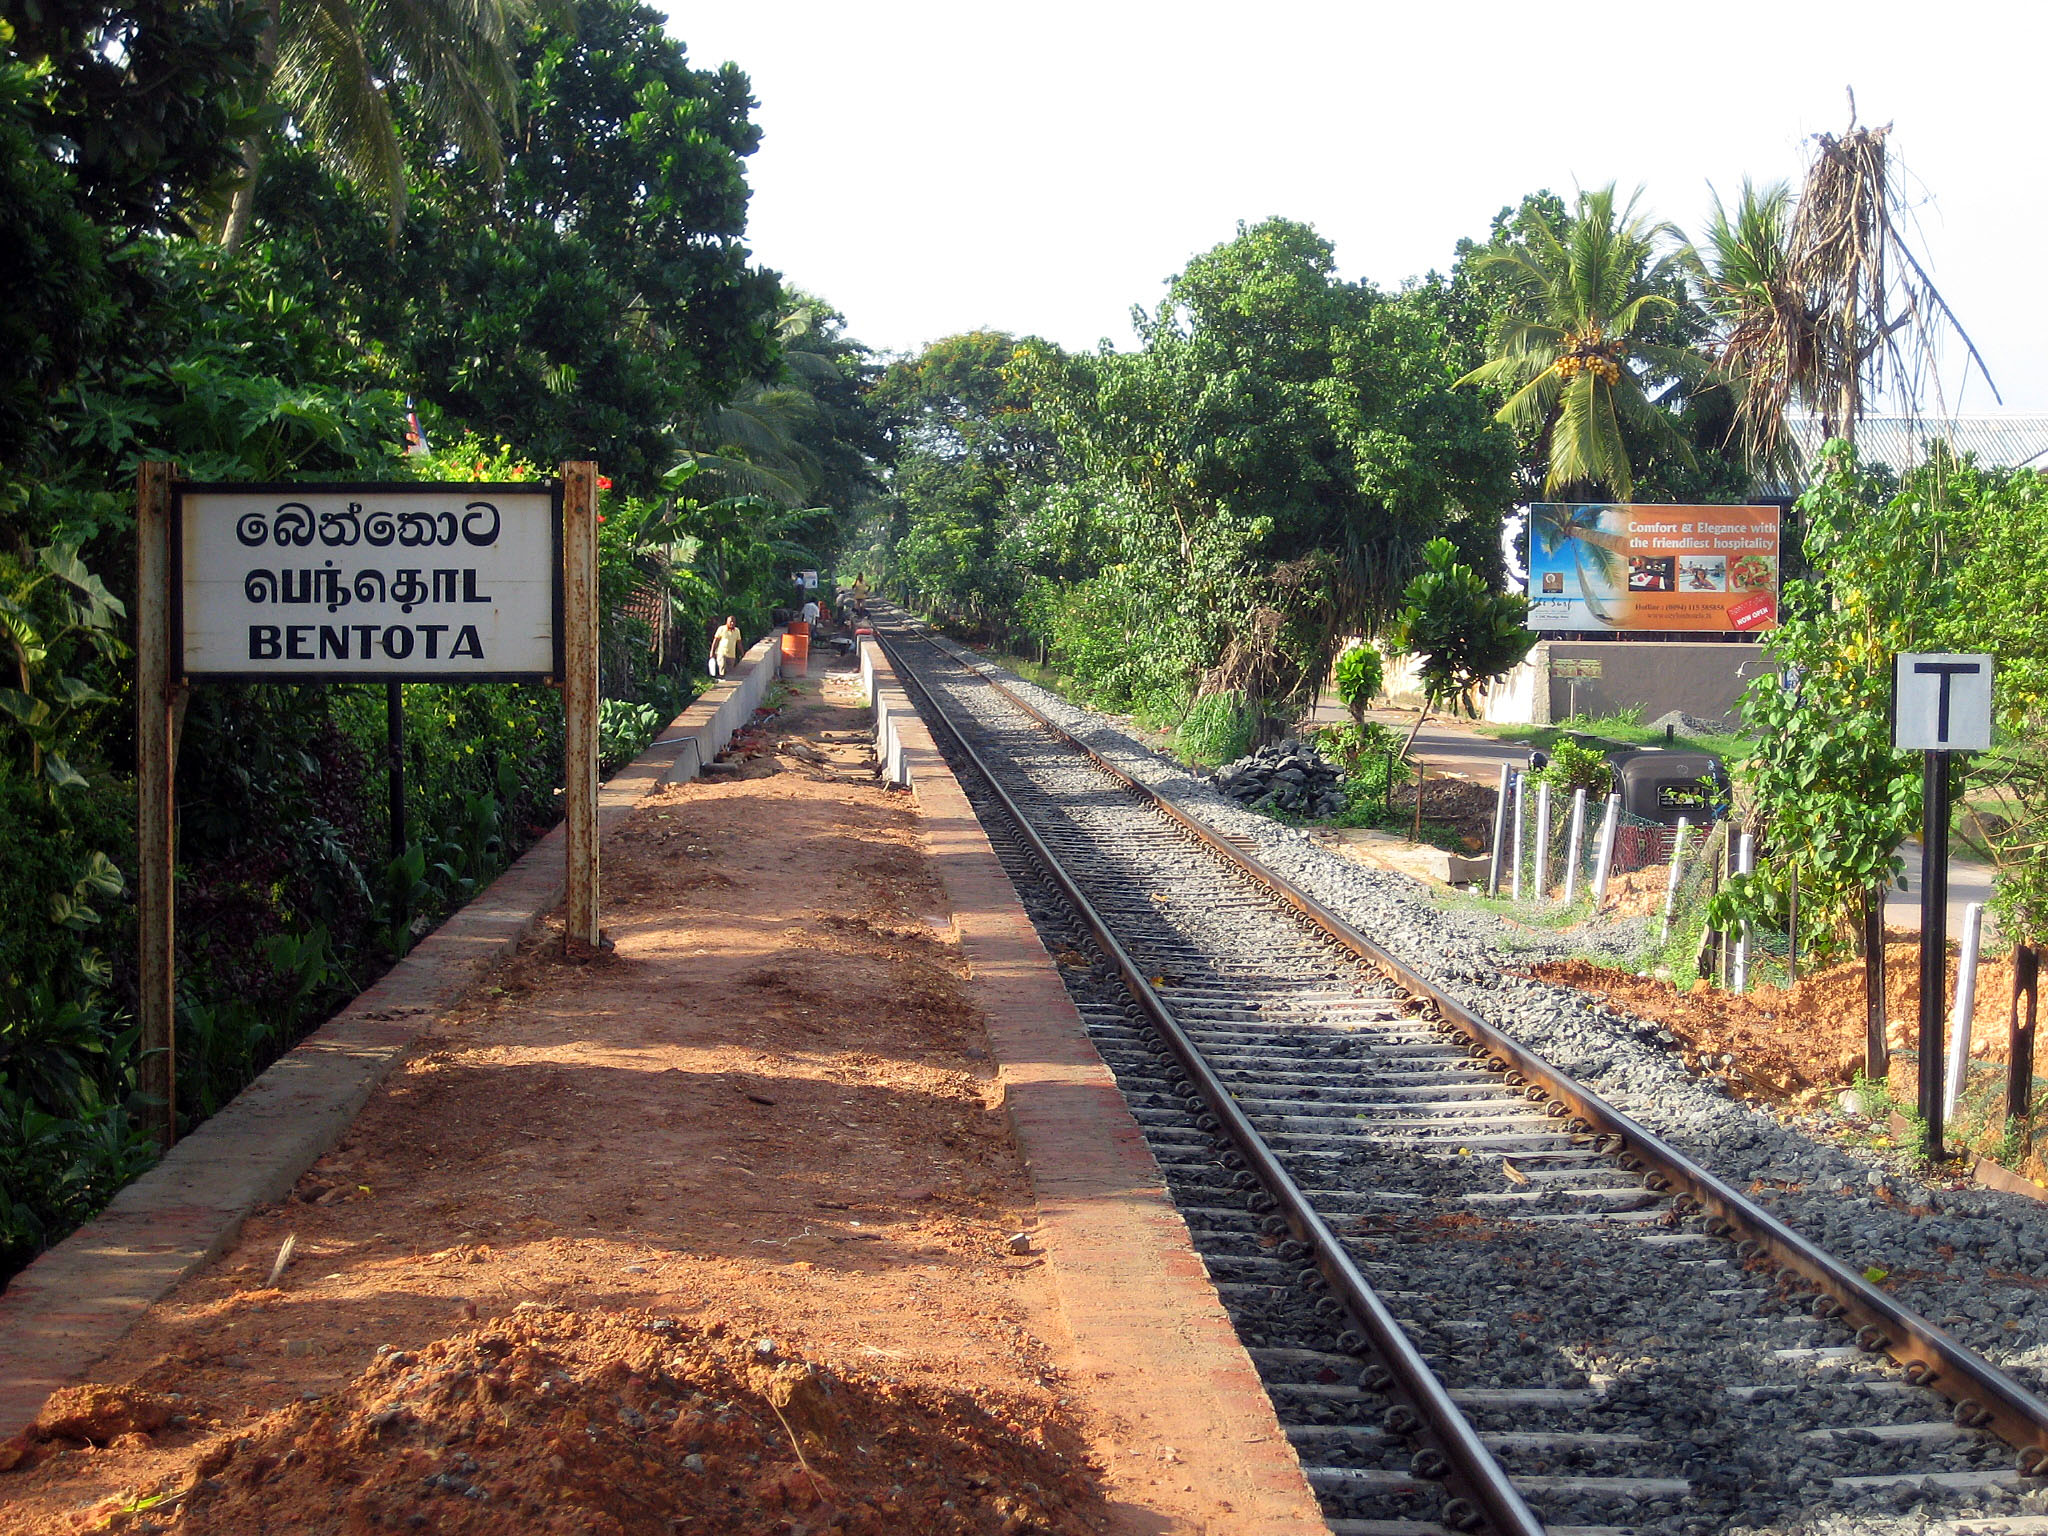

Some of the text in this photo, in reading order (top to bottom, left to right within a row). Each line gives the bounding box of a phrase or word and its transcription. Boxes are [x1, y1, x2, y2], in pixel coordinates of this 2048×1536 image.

[1628, 521, 1776, 535] Comfort & Elegance with
[1629, 537, 1774, 550] the friendliest hospitality
[1736, 606, 1769, 626] NOW OPEN
[248, 624, 485, 660] BENTOTA
[1914, 662, 1980, 743] T
